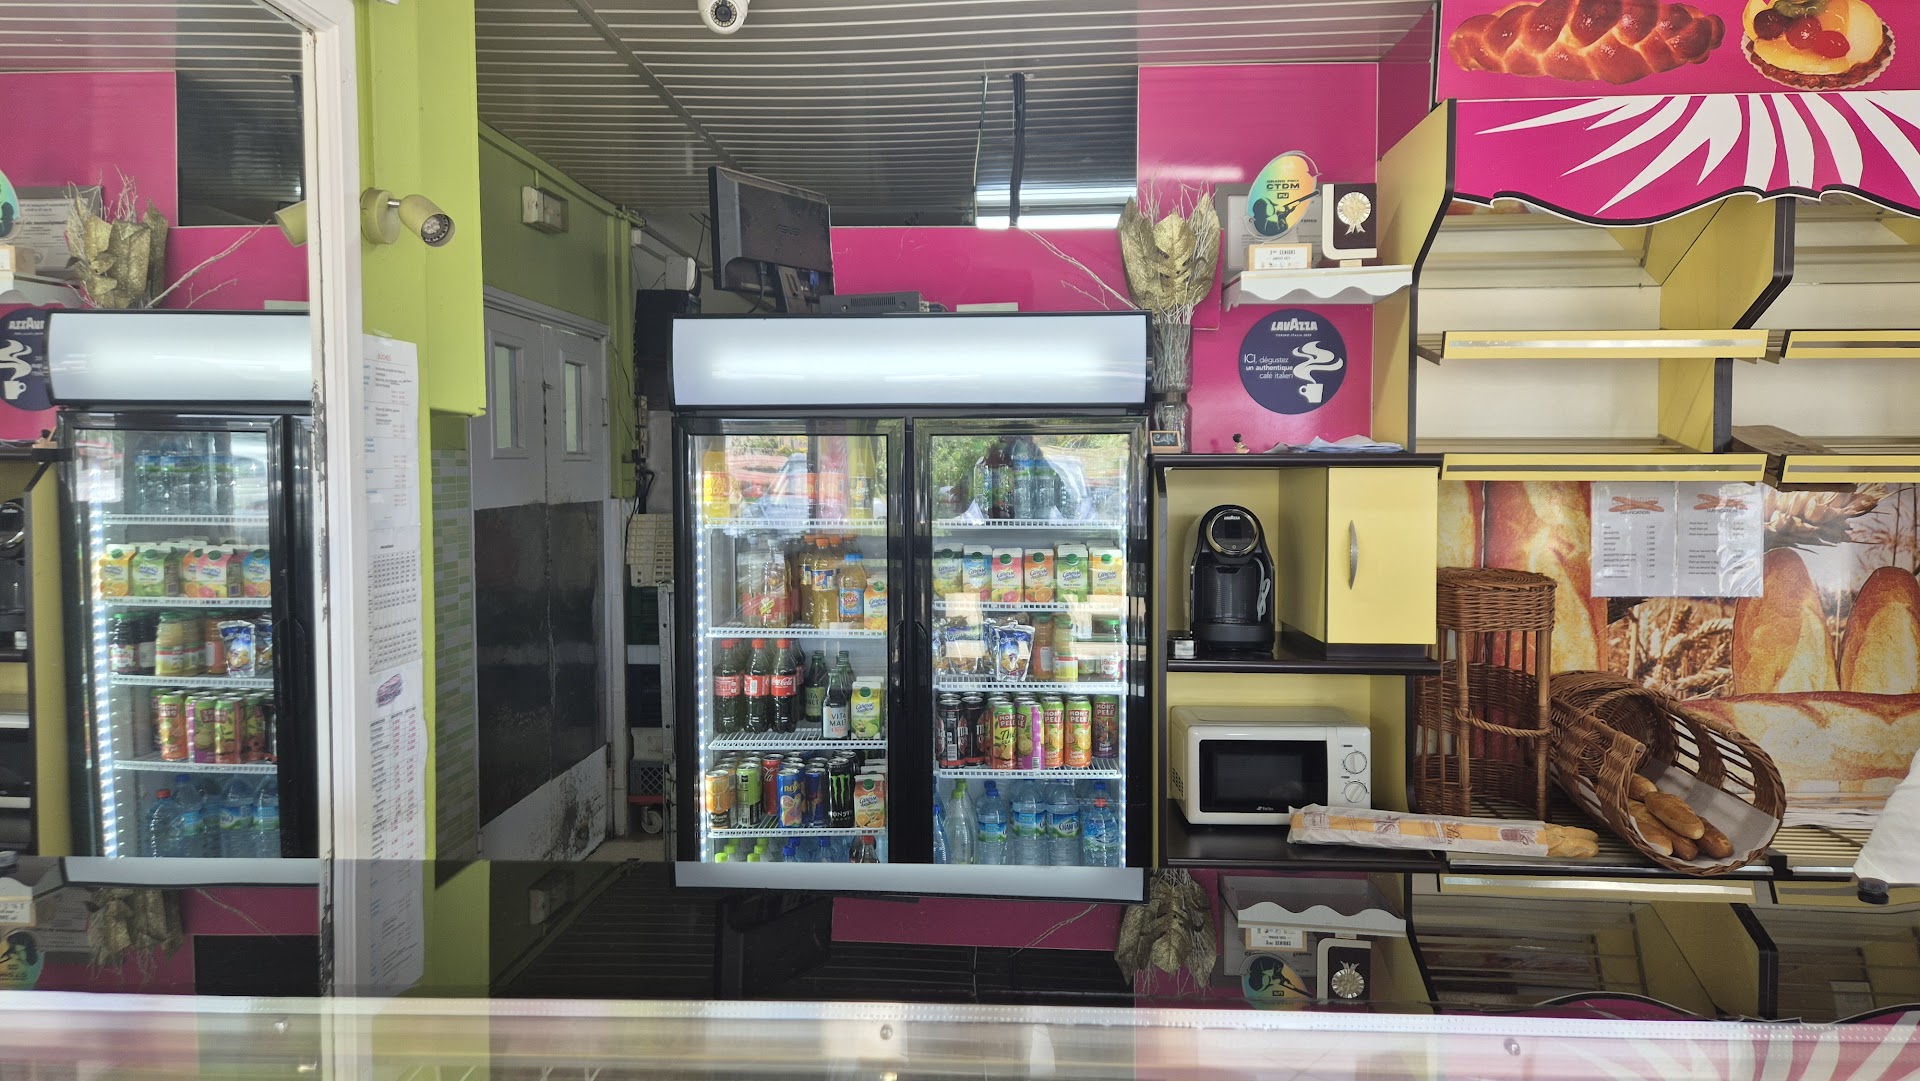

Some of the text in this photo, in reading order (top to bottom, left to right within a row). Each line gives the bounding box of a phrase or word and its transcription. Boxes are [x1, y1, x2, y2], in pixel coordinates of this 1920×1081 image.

[1266, 182, 1300, 190] CTDM
[1271, 318, 1318, 331] LAVAZZA
[1244, 353, 1289, 365] ICI, dégustez
[1255, 364, 1293, 372] authentique
[1259, 371, 1293, 379] café italien
[829, 719, 847, 727] MALT
